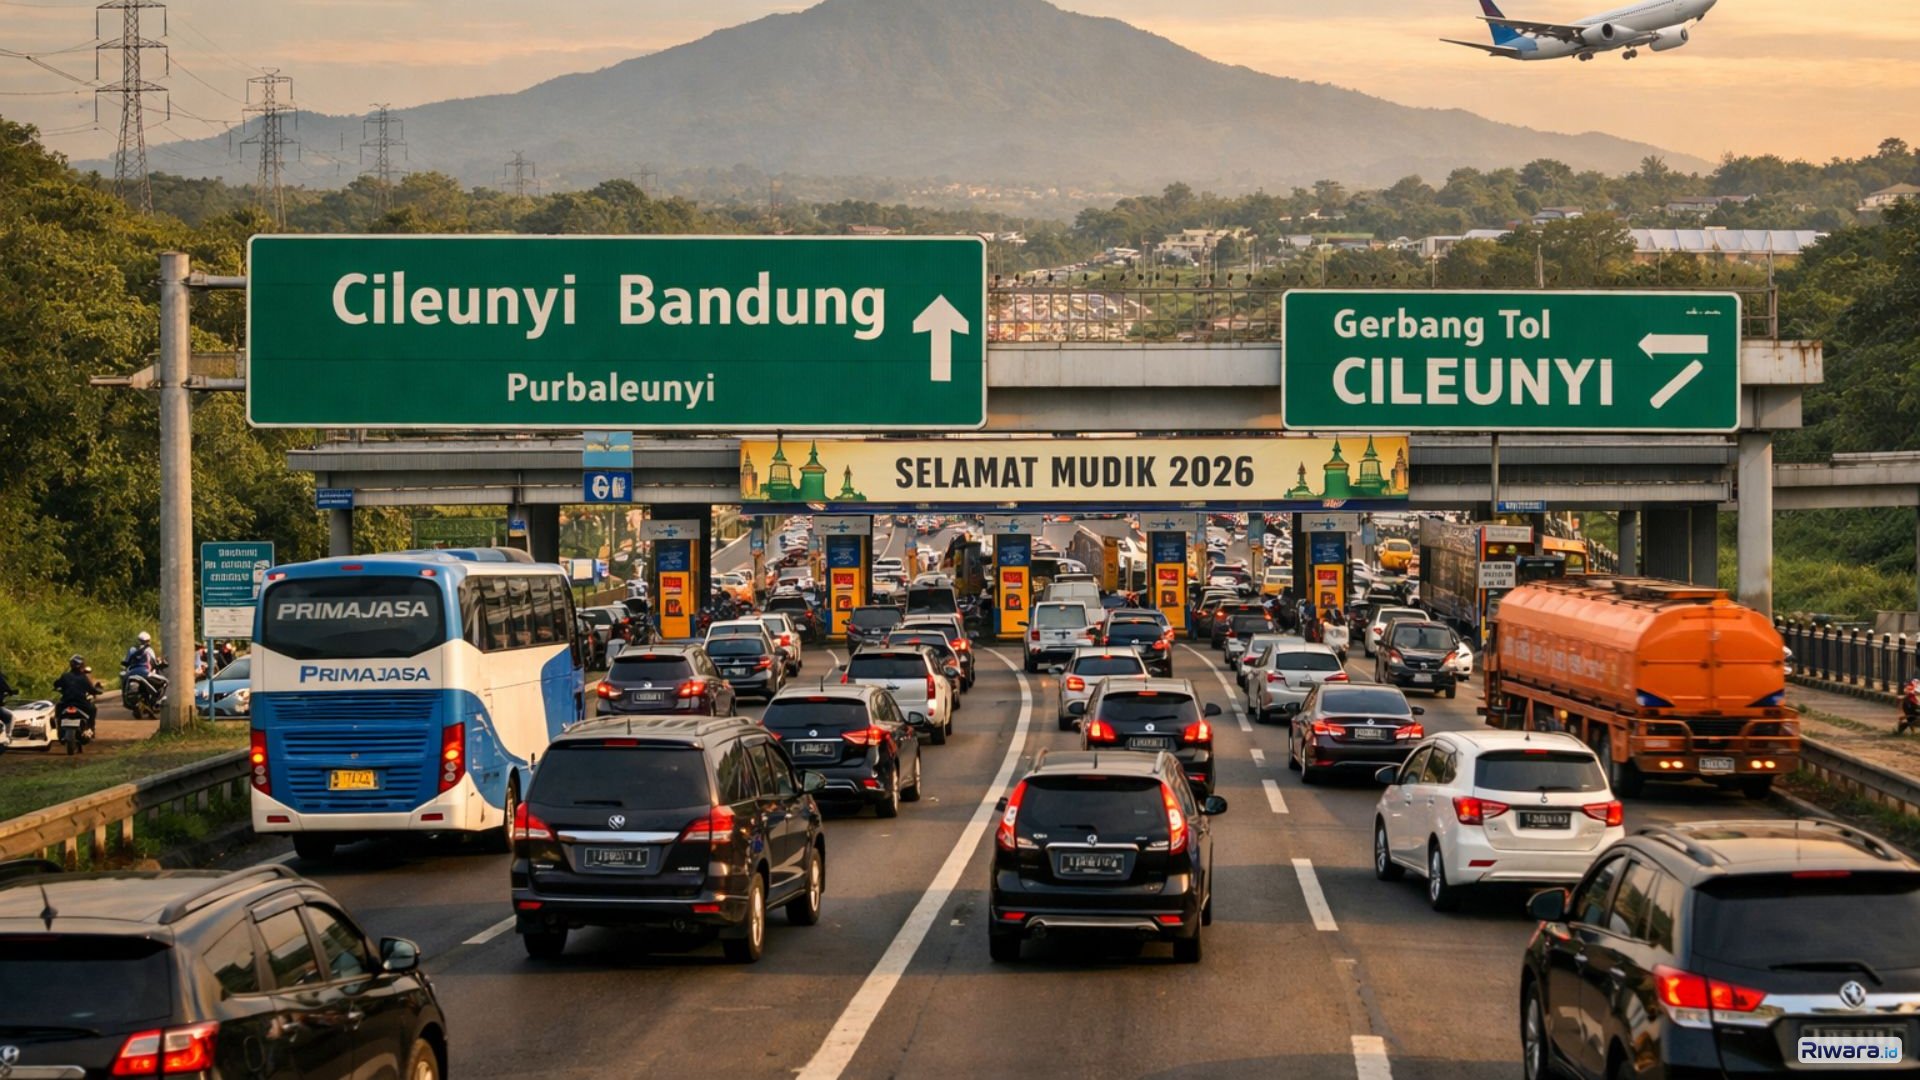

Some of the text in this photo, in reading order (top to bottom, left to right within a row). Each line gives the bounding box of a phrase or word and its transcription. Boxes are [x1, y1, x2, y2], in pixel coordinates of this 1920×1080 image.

[332, 271, 885, 341] Cileunyi Bandung
[1333, 307, 1550, 347] Gerbang Tol
[507, 371, 714, 410] Purbaleunyi
[1332, 357, 1613, 406] CILEUNYI
[895, 455, 1254, 489] SELAMAT MUDIK 2026
[277, 601, 429, 620] PRIMAJASA
[299, 665, 430, 683] PRIMAJASA
